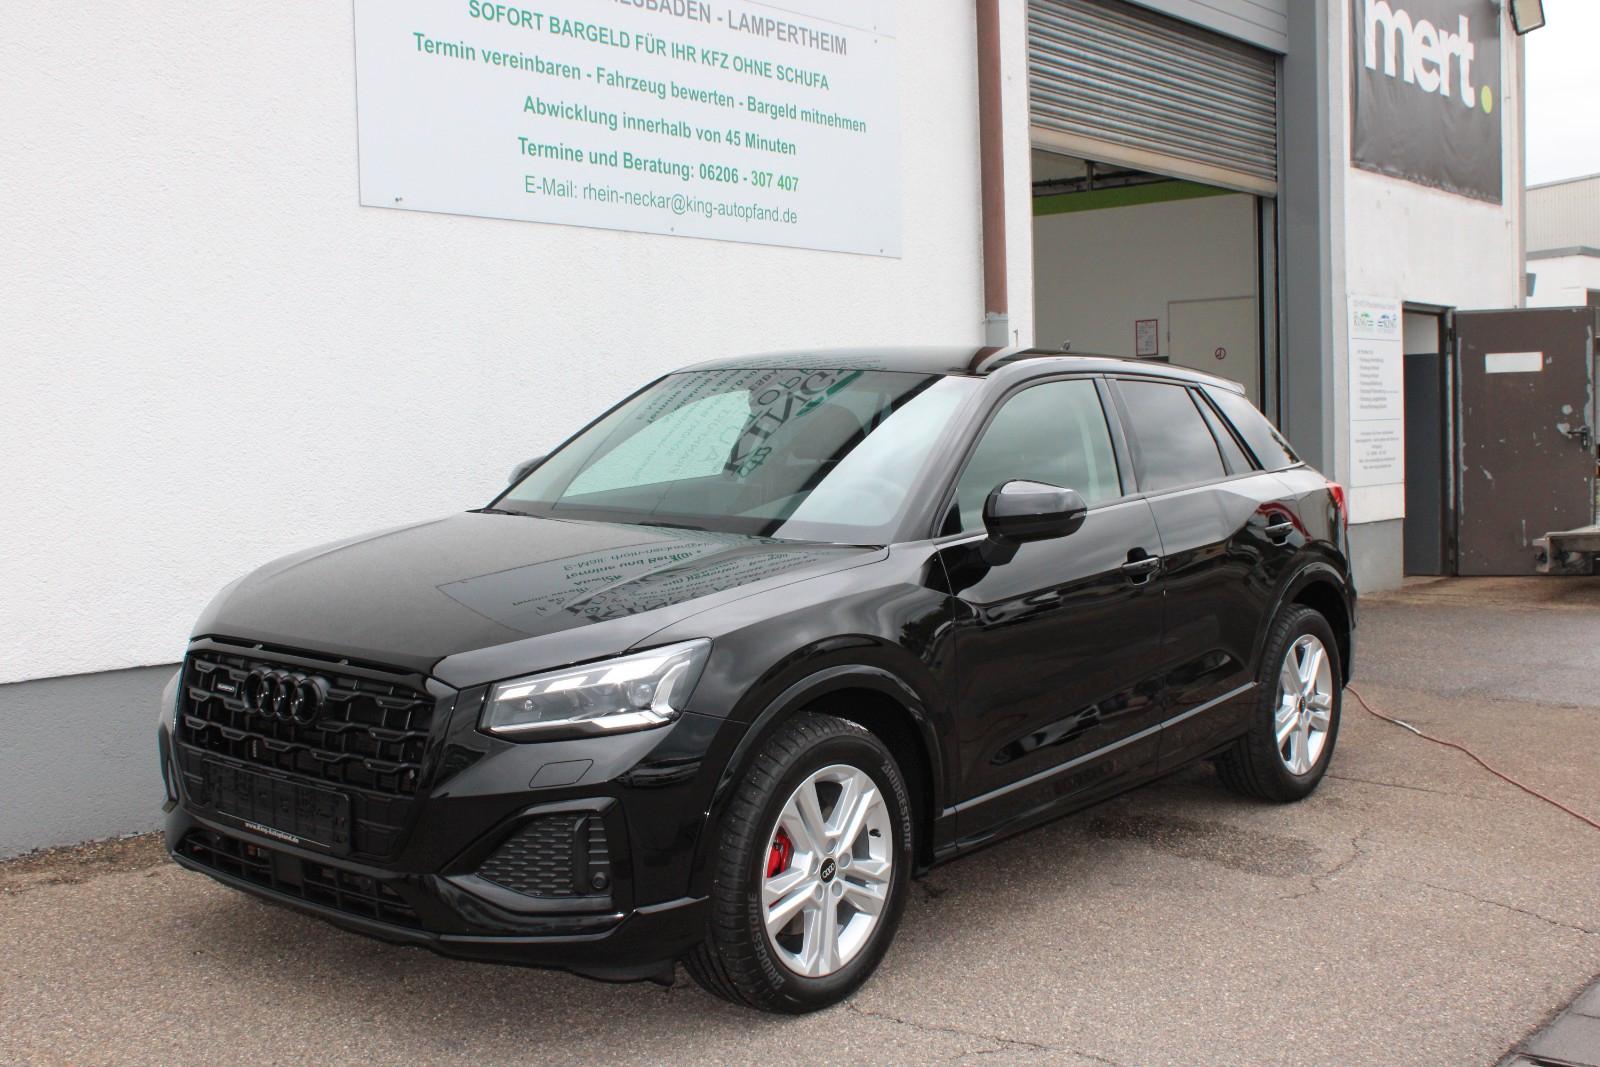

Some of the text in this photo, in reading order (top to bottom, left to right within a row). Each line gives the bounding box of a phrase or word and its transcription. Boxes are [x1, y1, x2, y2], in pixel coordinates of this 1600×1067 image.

[468, 0, 829, 90] SOFORT BARGELD FÜR IHR KFZ OHNE SCHUFA
[728, 9, 847, 56] LAMPERTHEIM
[412, 32, 476, 61] Termin
[481, 49, 581, 80] vereinbaren
[596, 66, 666, 99] Fahrzeug
[671, 81, 735, 108] bewerten
[748, 96, 797, 120] Bargeld
[800, 107, 867, 133] mitnehmen
[523, 95, 796, 156] Abwicklung innerhalb von 45 Minuten
[517, 136, 584, 163] Termine
[589, 151, 618, 167] und
[623, 151, 695, 181] Beratung:
[699, 163, 739, 184] 06206
[751, 170, 774, 188] 307
[777, 174, 799, 192] 407
[525, 175, 798, 224] E-Mail: rhein-neckar@king-autopfand.de
